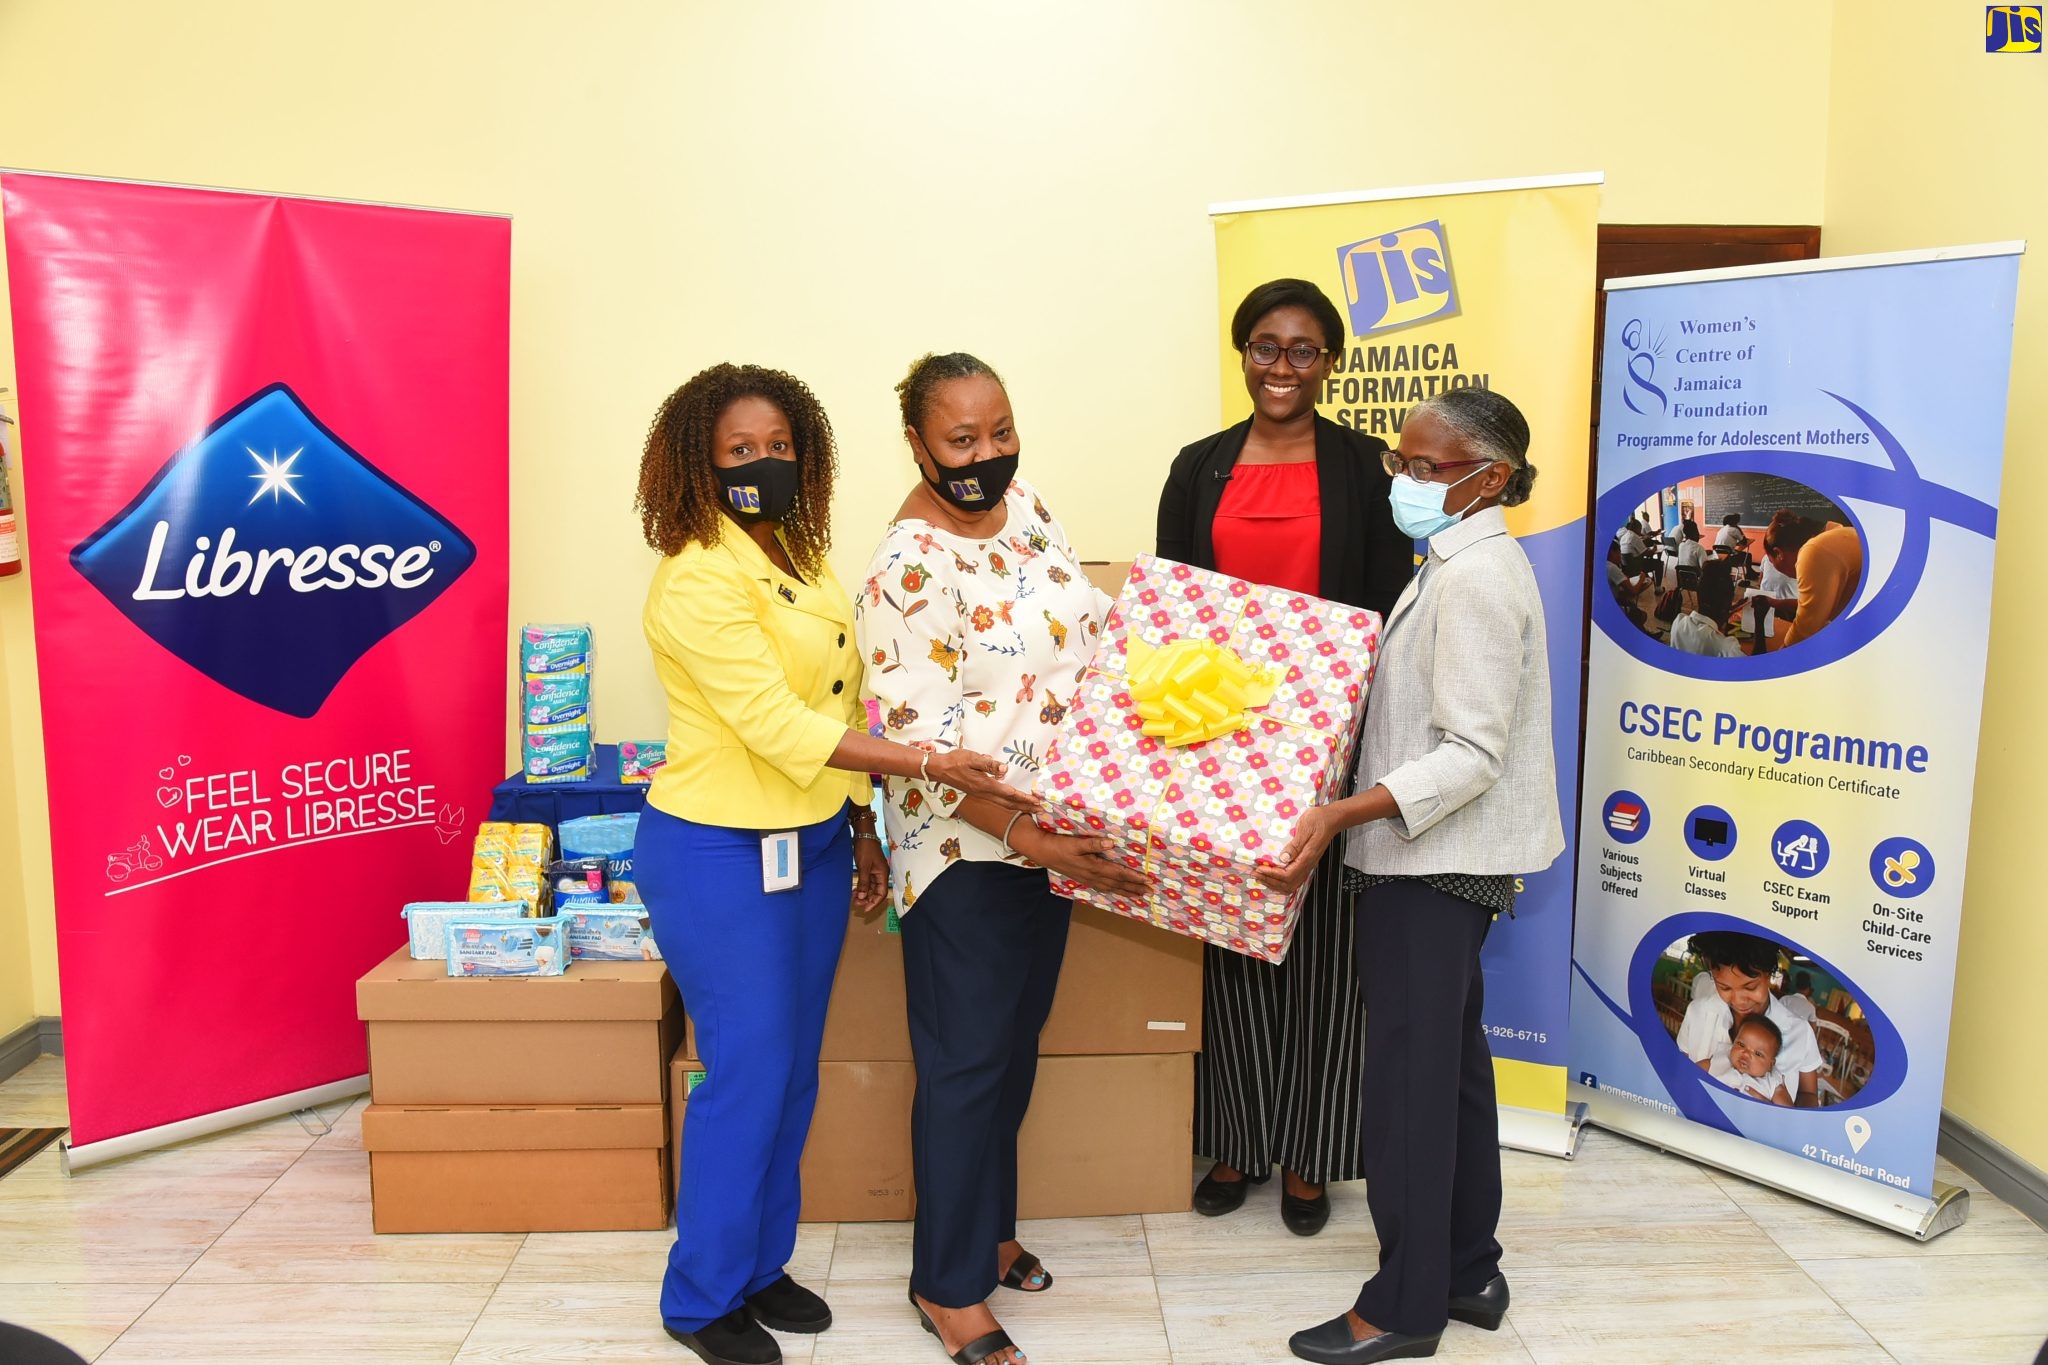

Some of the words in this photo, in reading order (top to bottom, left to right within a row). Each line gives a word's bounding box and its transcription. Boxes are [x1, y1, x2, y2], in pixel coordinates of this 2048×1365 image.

[1333, 343, 1459, 374] JAMAICA
[1676, 347, 1732, 363] Centre
[1737, 345, 1755, 361] of
[1673, 375, 1742, 392] Jamaica
[1673, 402, 1768, 418] Foundation
[1617, 433, 1694, 450] Programme
[1697, 431, 1717, 446] for
[1720, 430, 1802, 446] Adolescent
[1806, 428, 1870, 445] Mothers
[550, 657, 580, 670] Overnight
[535, 689, 580, 702] Confidence
[551, 709, 582, 721] Overnight
[1619, 701, 1703, 743] CSEC
[1713, 712, 1930, 774] Programme
[535, 741, 580, 754] Confidence
[637, 749, 666, 760] Confiden
[551, 761, 582, 773] Overnight
[1627, 746, 1686, 767] Caribbean
[1689, 755, 1755, 781] Secondary
[1757, 765, 1824, 788] Education
[1828, 775, 1900, 800] Certificate
[185, 769, 271, 814] FEEL
[281, 749, 411, 799] SECURE
[157, 809, 276, 858] WEAR
[286, 784, 436, 839] LIBRESSE
[1602, 847, 1639, 866] Various
[1600, 863, 1642, 883] Subjects
[1688, 865, 1726, 883] Virtual
[1601, 880, 1638, 899] Offered
[1684, 882, 1727, 901] Classes
[1763, 880, 1795, 898] CSEC
[1797, 887, 1831, 905] Exam
[1771, 900, 1819, 921] Support
[1872, 903, 1924, 923] On-Site
[1862, 919, 1932, 944] Child-Care
[1866, 939, 1923, 962] Services
[1801, 1143, 1817, 1158] 42
[1820, 1148, 1875, 1176] Trafalgar
[1877, 1167, 1910, 1189] Road
